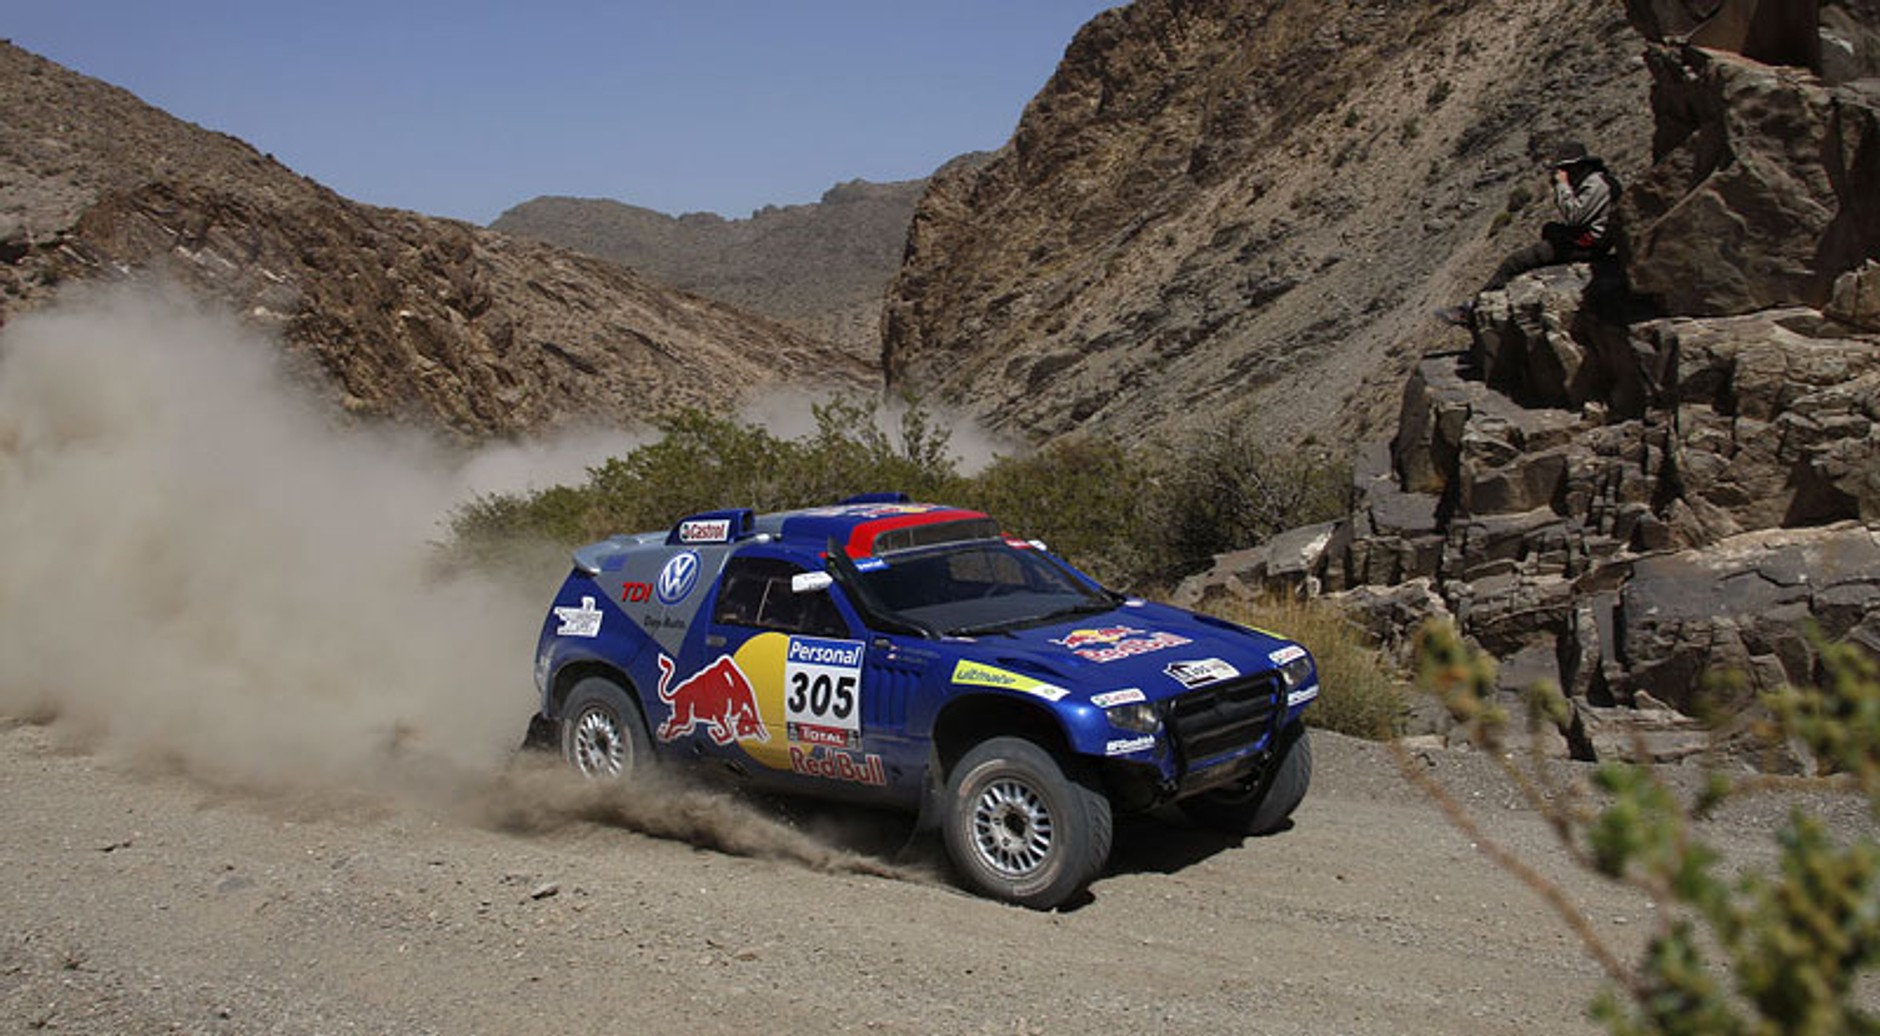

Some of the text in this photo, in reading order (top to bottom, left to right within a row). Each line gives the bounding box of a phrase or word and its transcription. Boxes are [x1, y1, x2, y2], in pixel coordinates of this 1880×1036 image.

[691, 523, 725, 539] Castrol
[621, 582, 653, 603] TDI
[789, 641, 860, 665] Personal
[788, 671, 857, 719] 305
[802, 726, 845, 744] TOTAL
[789, 746, 887, 785] Red Bull
